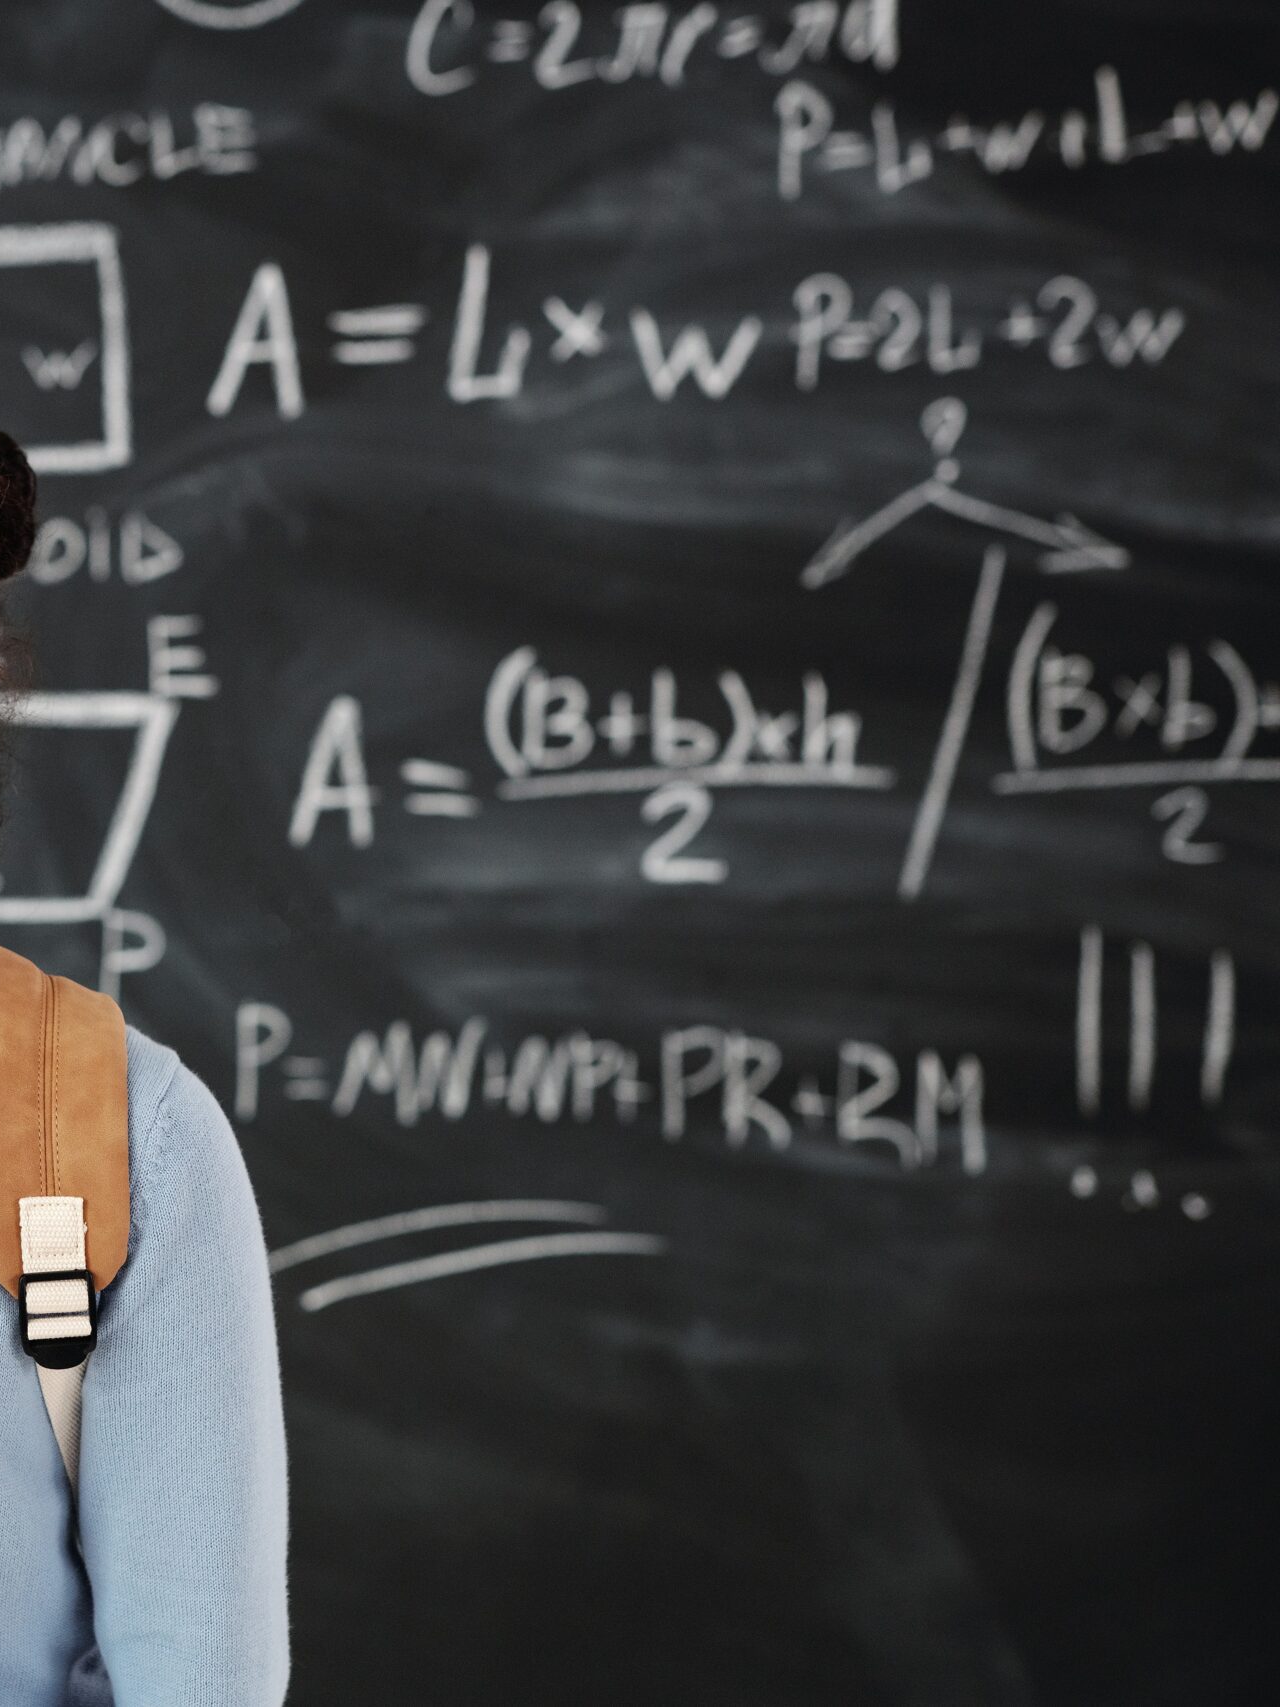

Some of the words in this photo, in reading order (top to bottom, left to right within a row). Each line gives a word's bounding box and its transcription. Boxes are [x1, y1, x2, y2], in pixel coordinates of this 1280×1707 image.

[206, 260, 305, 420] A
[146, 613, 220, 699] E
[287, 693, 375, 848] A
[639, 778, 728, 885] 2
[1150, 786, 1222, 865] 2
[98, 905, 167, 998] P
